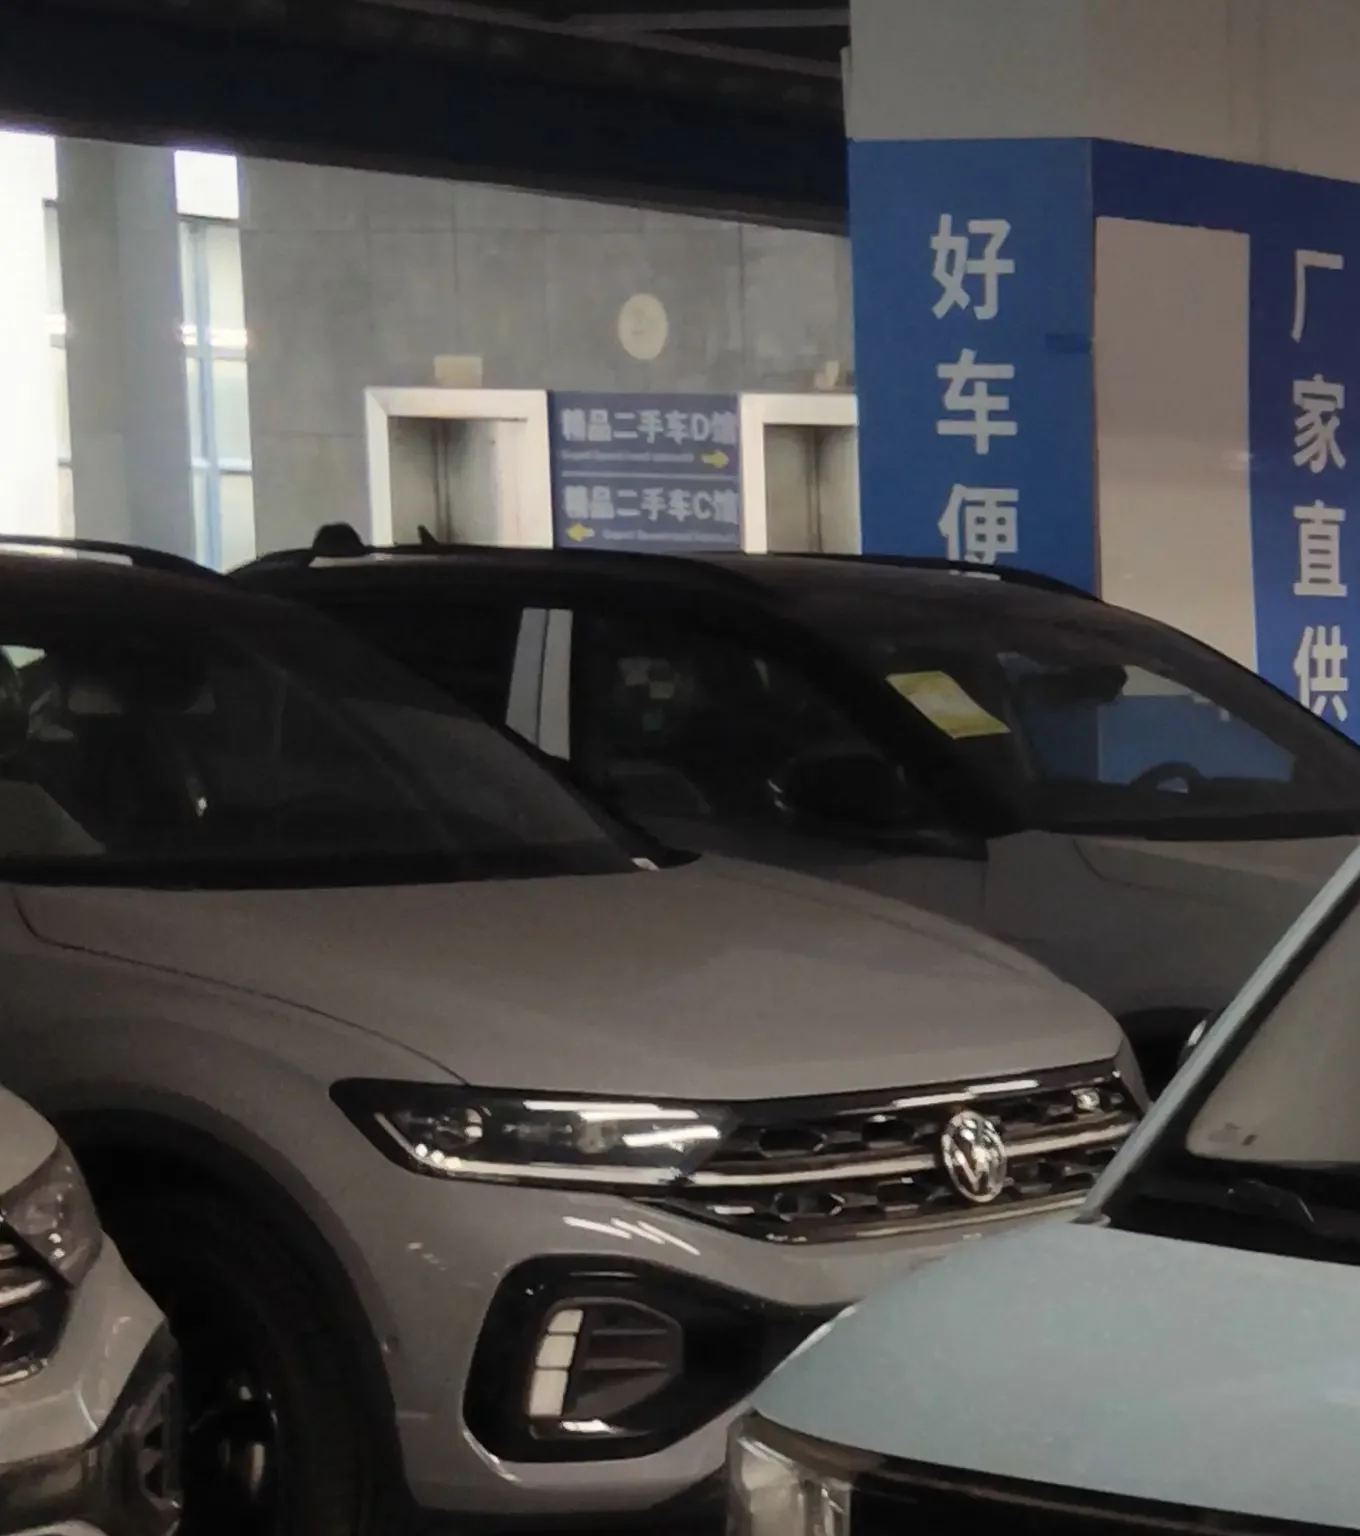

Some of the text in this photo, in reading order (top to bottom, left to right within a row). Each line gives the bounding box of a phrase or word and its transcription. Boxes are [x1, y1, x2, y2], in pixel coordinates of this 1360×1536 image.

[930, 213, 1018, 566] 好车便
[1291, 249, 1349, 721] 厂家直供
